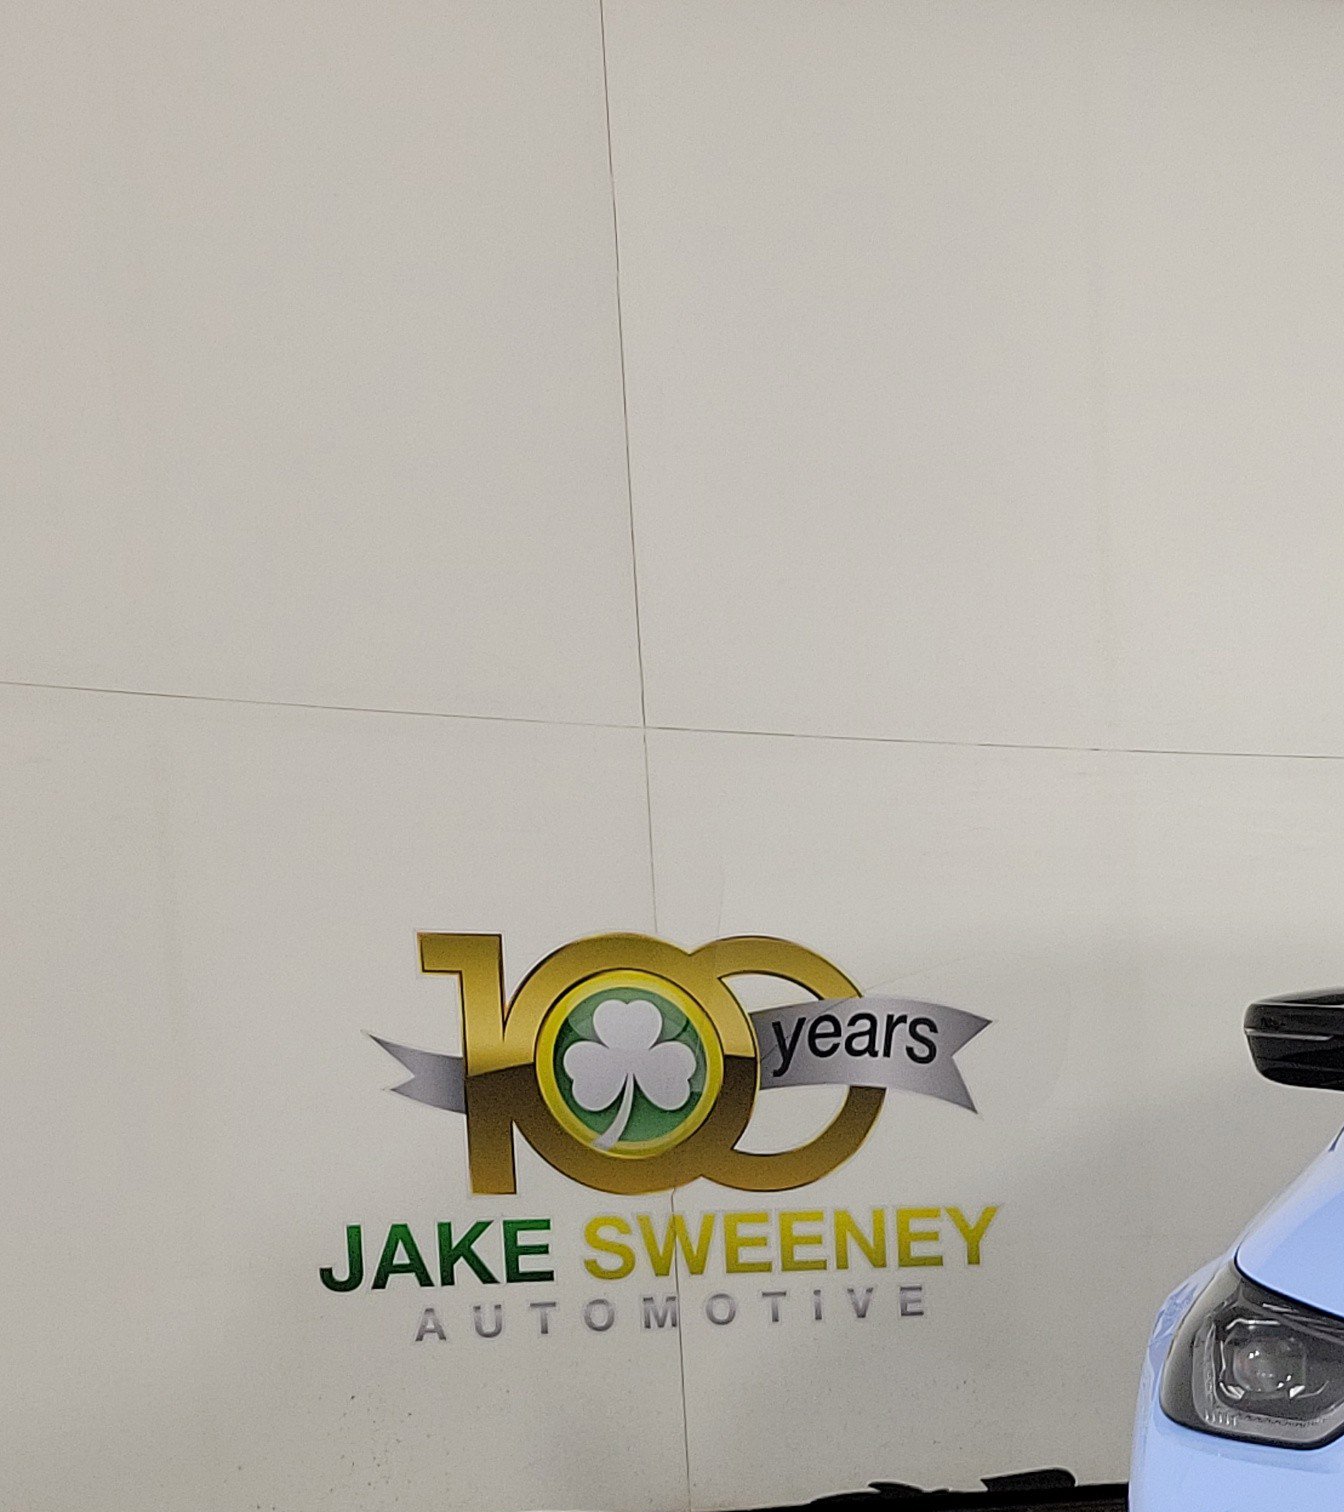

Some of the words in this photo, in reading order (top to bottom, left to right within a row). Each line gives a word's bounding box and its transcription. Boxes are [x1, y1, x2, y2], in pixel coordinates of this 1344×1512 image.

[416, 931, 888, 1195] 100
[772, 1011, 939, 1078] years
[318, 1218, 556, 1293] JAKE
[583, 1205, 1000, 1280] SWEENEY
[414, 1284, 926, 1343] AUTOMOTIVE
